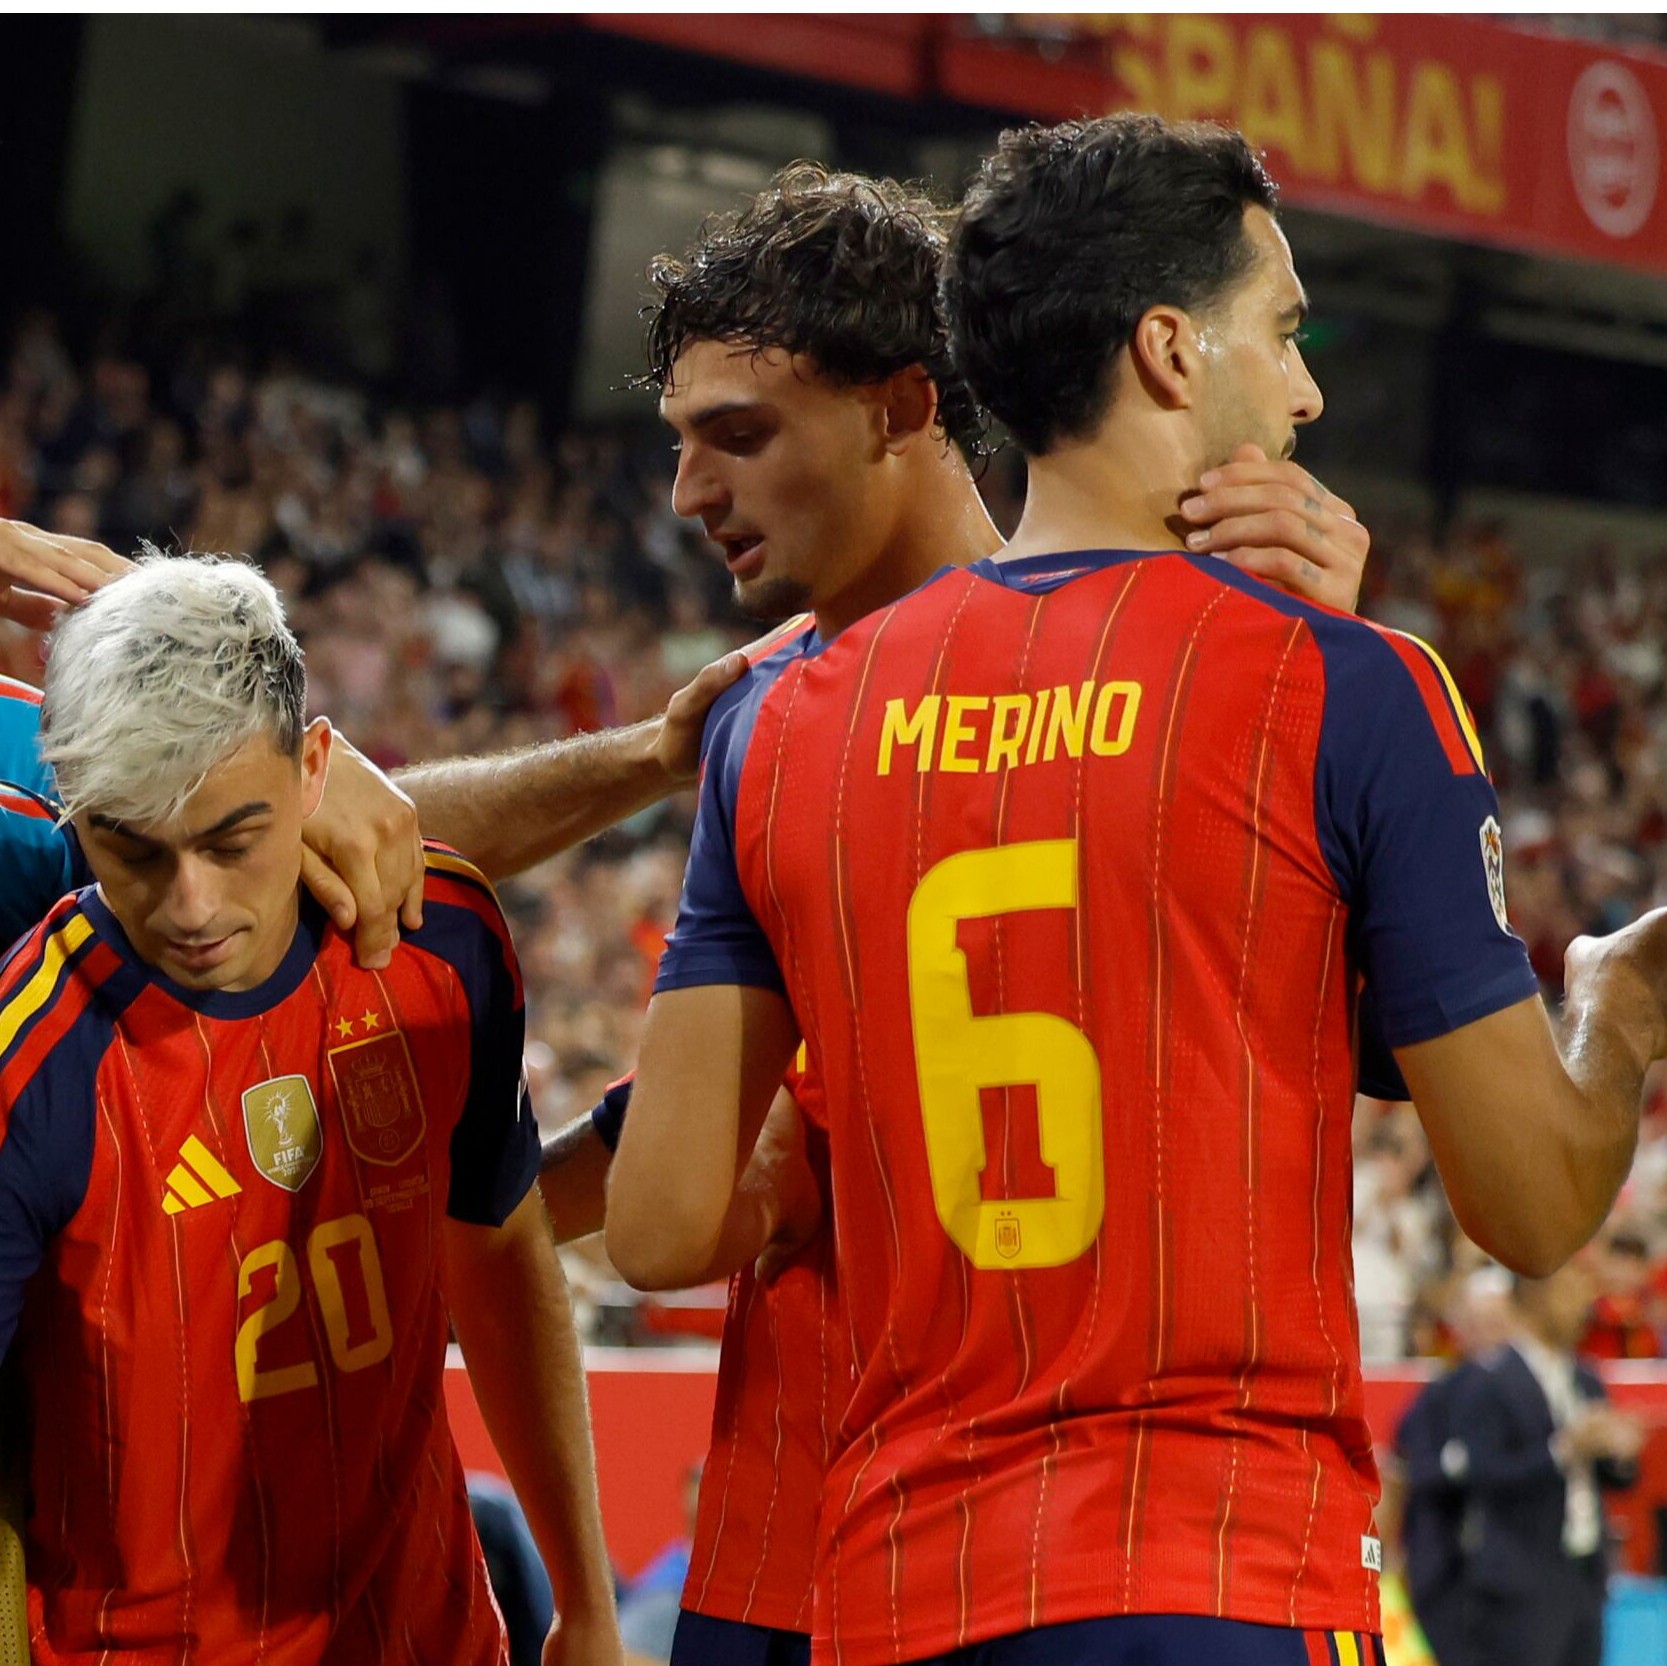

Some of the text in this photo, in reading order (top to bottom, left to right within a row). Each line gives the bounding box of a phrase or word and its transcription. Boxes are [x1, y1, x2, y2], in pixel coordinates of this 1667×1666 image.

[877, 679, 1142, 776] MERINO
[907, 838, 1105, 1269] 6
[273, 1147, 304, 1165] FIFA
[234, 1213, 394, 1402] 20
